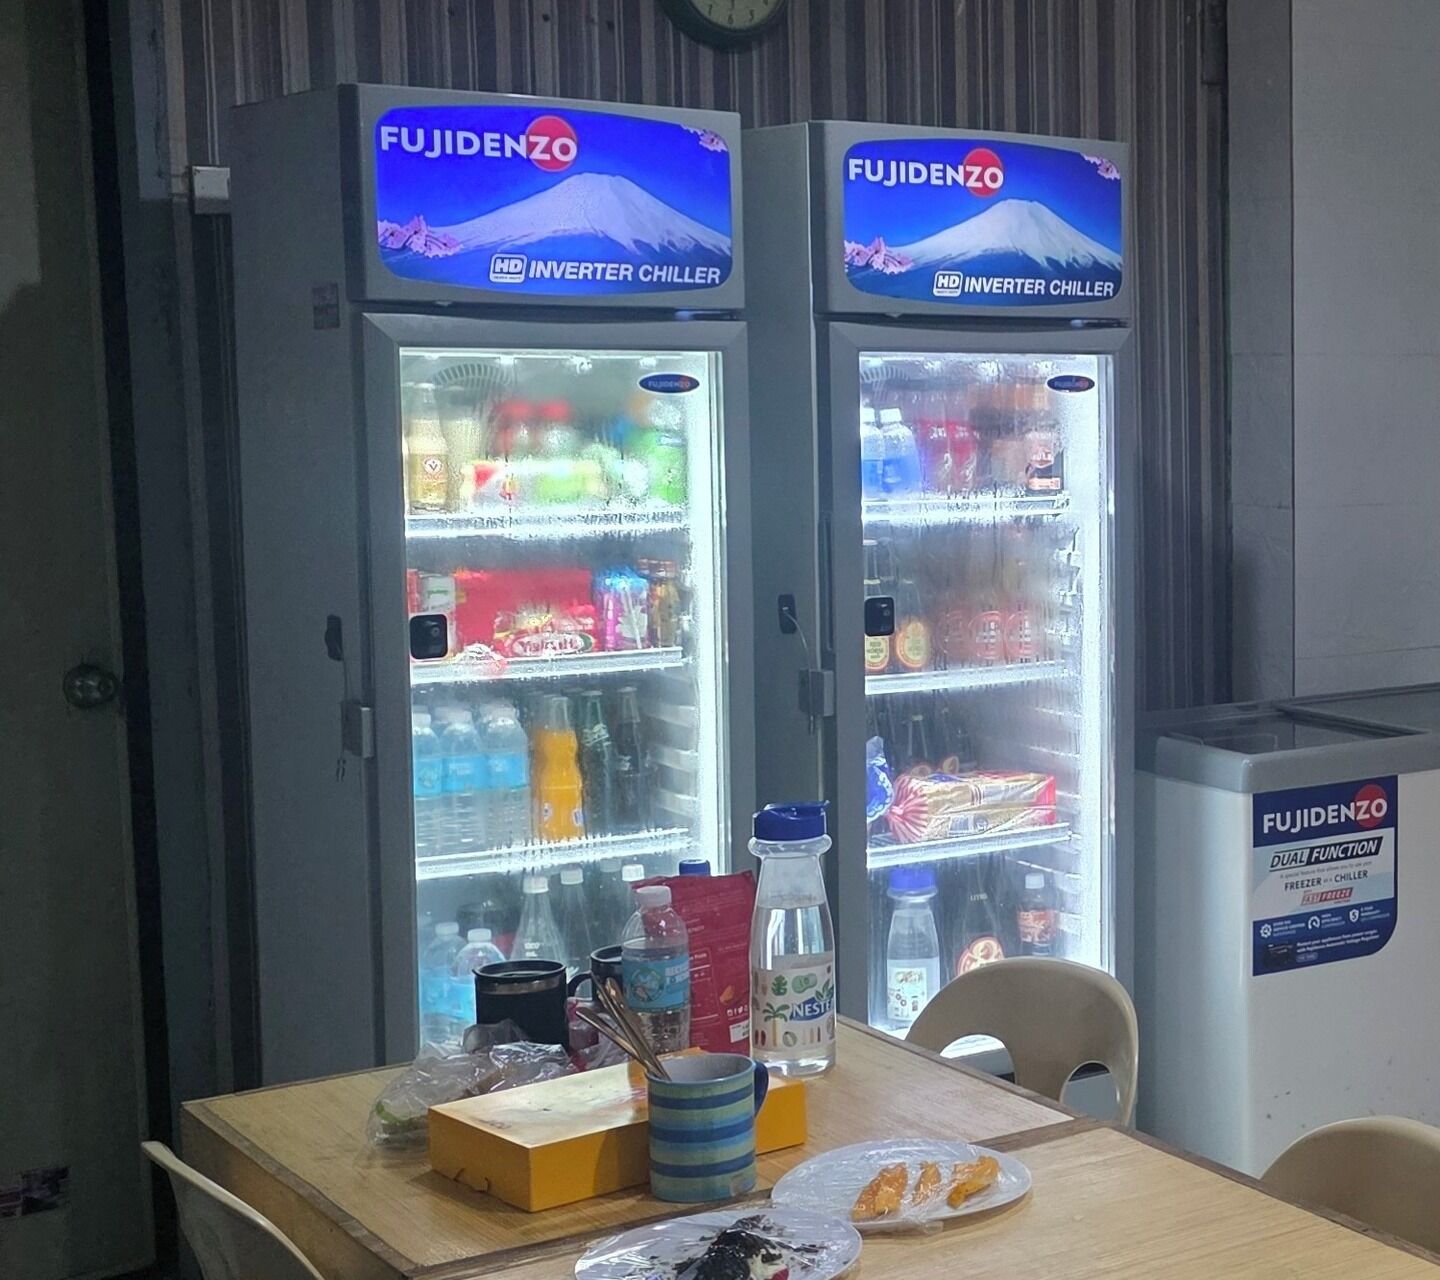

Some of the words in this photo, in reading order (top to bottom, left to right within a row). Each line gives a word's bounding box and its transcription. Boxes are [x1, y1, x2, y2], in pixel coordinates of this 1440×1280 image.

[380, 125, 577, 162] FUJIDENZO
[849, 158, 1004, 189] FUJIDENZO
[494, 258, 523, 273] HD
[529, 260, 633, 282] INVERTER
[638, 264, 721, 285] CHILLER
[937, 274, 960, 288] HD
[964, 276, 1046, 294] INVERTER
[1050, 279, 1114, 297] CHILLER
[1263, 798, 1388, 834] FUJIDENZO
[1270, 848, 1307, 869] DUAL
[1311, 839, 1378, 862] FUNCTION
[1284, 876, 1322, 891] FREEZER
[1334, 870, 1369, 884] CHILLER
